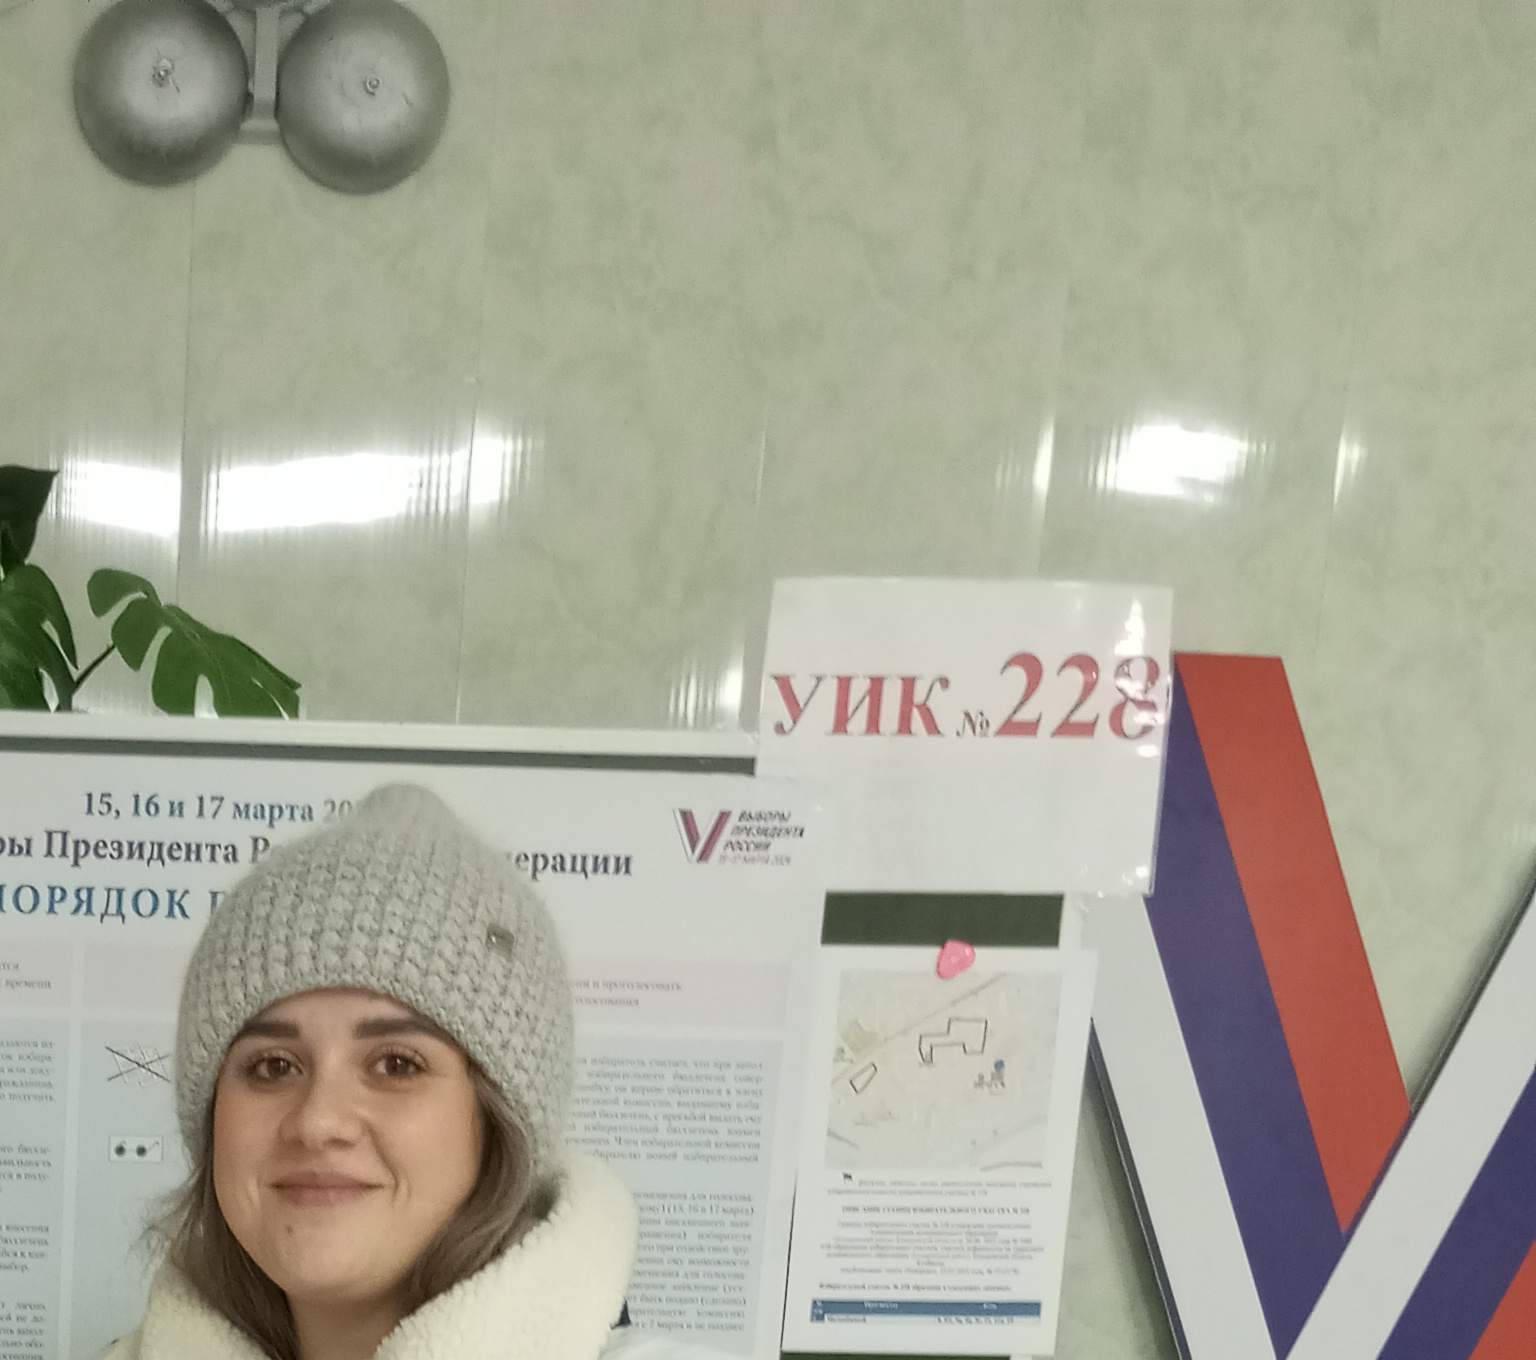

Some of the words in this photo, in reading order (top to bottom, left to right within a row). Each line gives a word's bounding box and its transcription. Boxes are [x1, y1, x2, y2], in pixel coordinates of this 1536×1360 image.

[770, 675, 951, 737] УИК
[956, 711, 990, 737] №
[994, 653, 1161, 740] 228
[85, 792, 121, 819] 15,
[132, 793, 160, 817] 16
[168, 800, 185, 818] и
[196, 795, 225, 819] 17
[232, 802, 314, 829] марта
[43, 830, 239, 867] Президента
